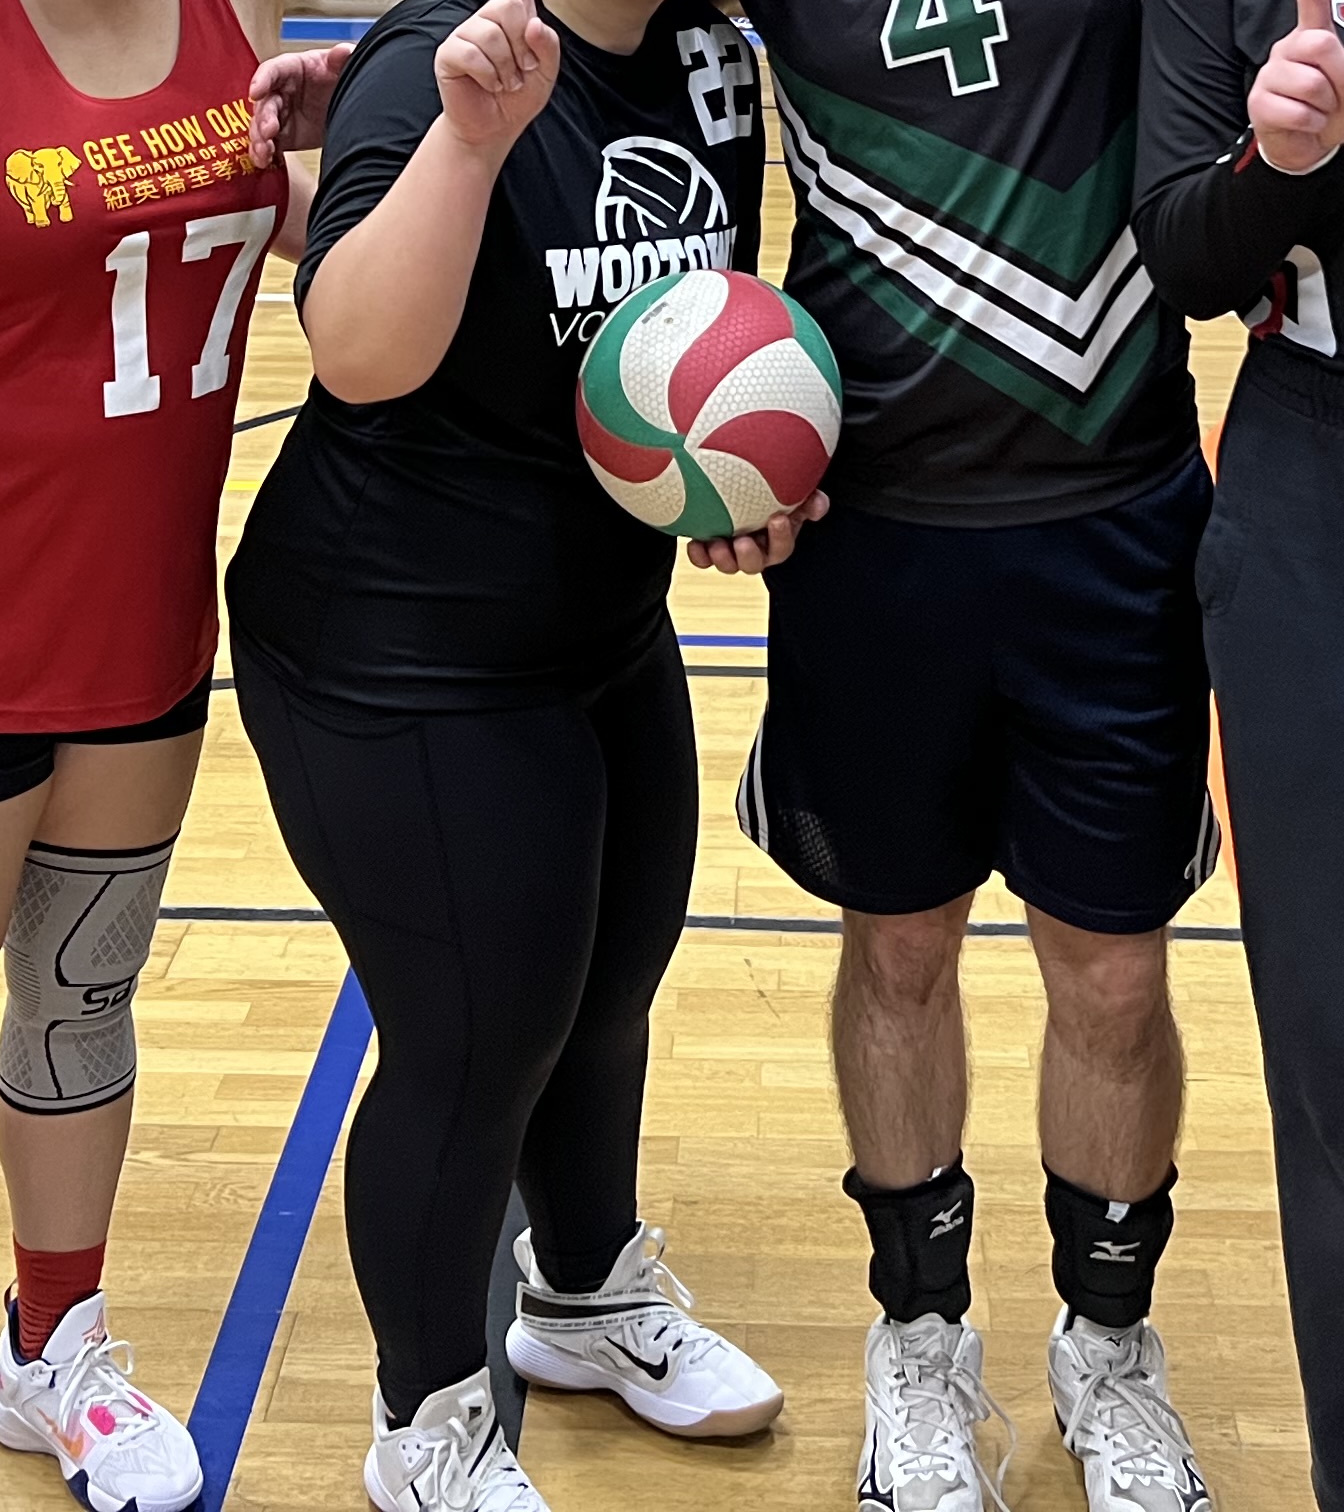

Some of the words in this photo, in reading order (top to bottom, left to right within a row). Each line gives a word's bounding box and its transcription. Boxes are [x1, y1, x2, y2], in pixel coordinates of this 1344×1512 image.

[676, 23, 754, 146] 22
[82, 134, 142, 172] GEE
[139, 115, 207, 158] HOW
[97, 152, 198, 187] ASSOCIATION
[198, 145, 218, 161] OF
[546, 224, 737, 308] WOOTOW
[103, 205, 277, 418] 17
